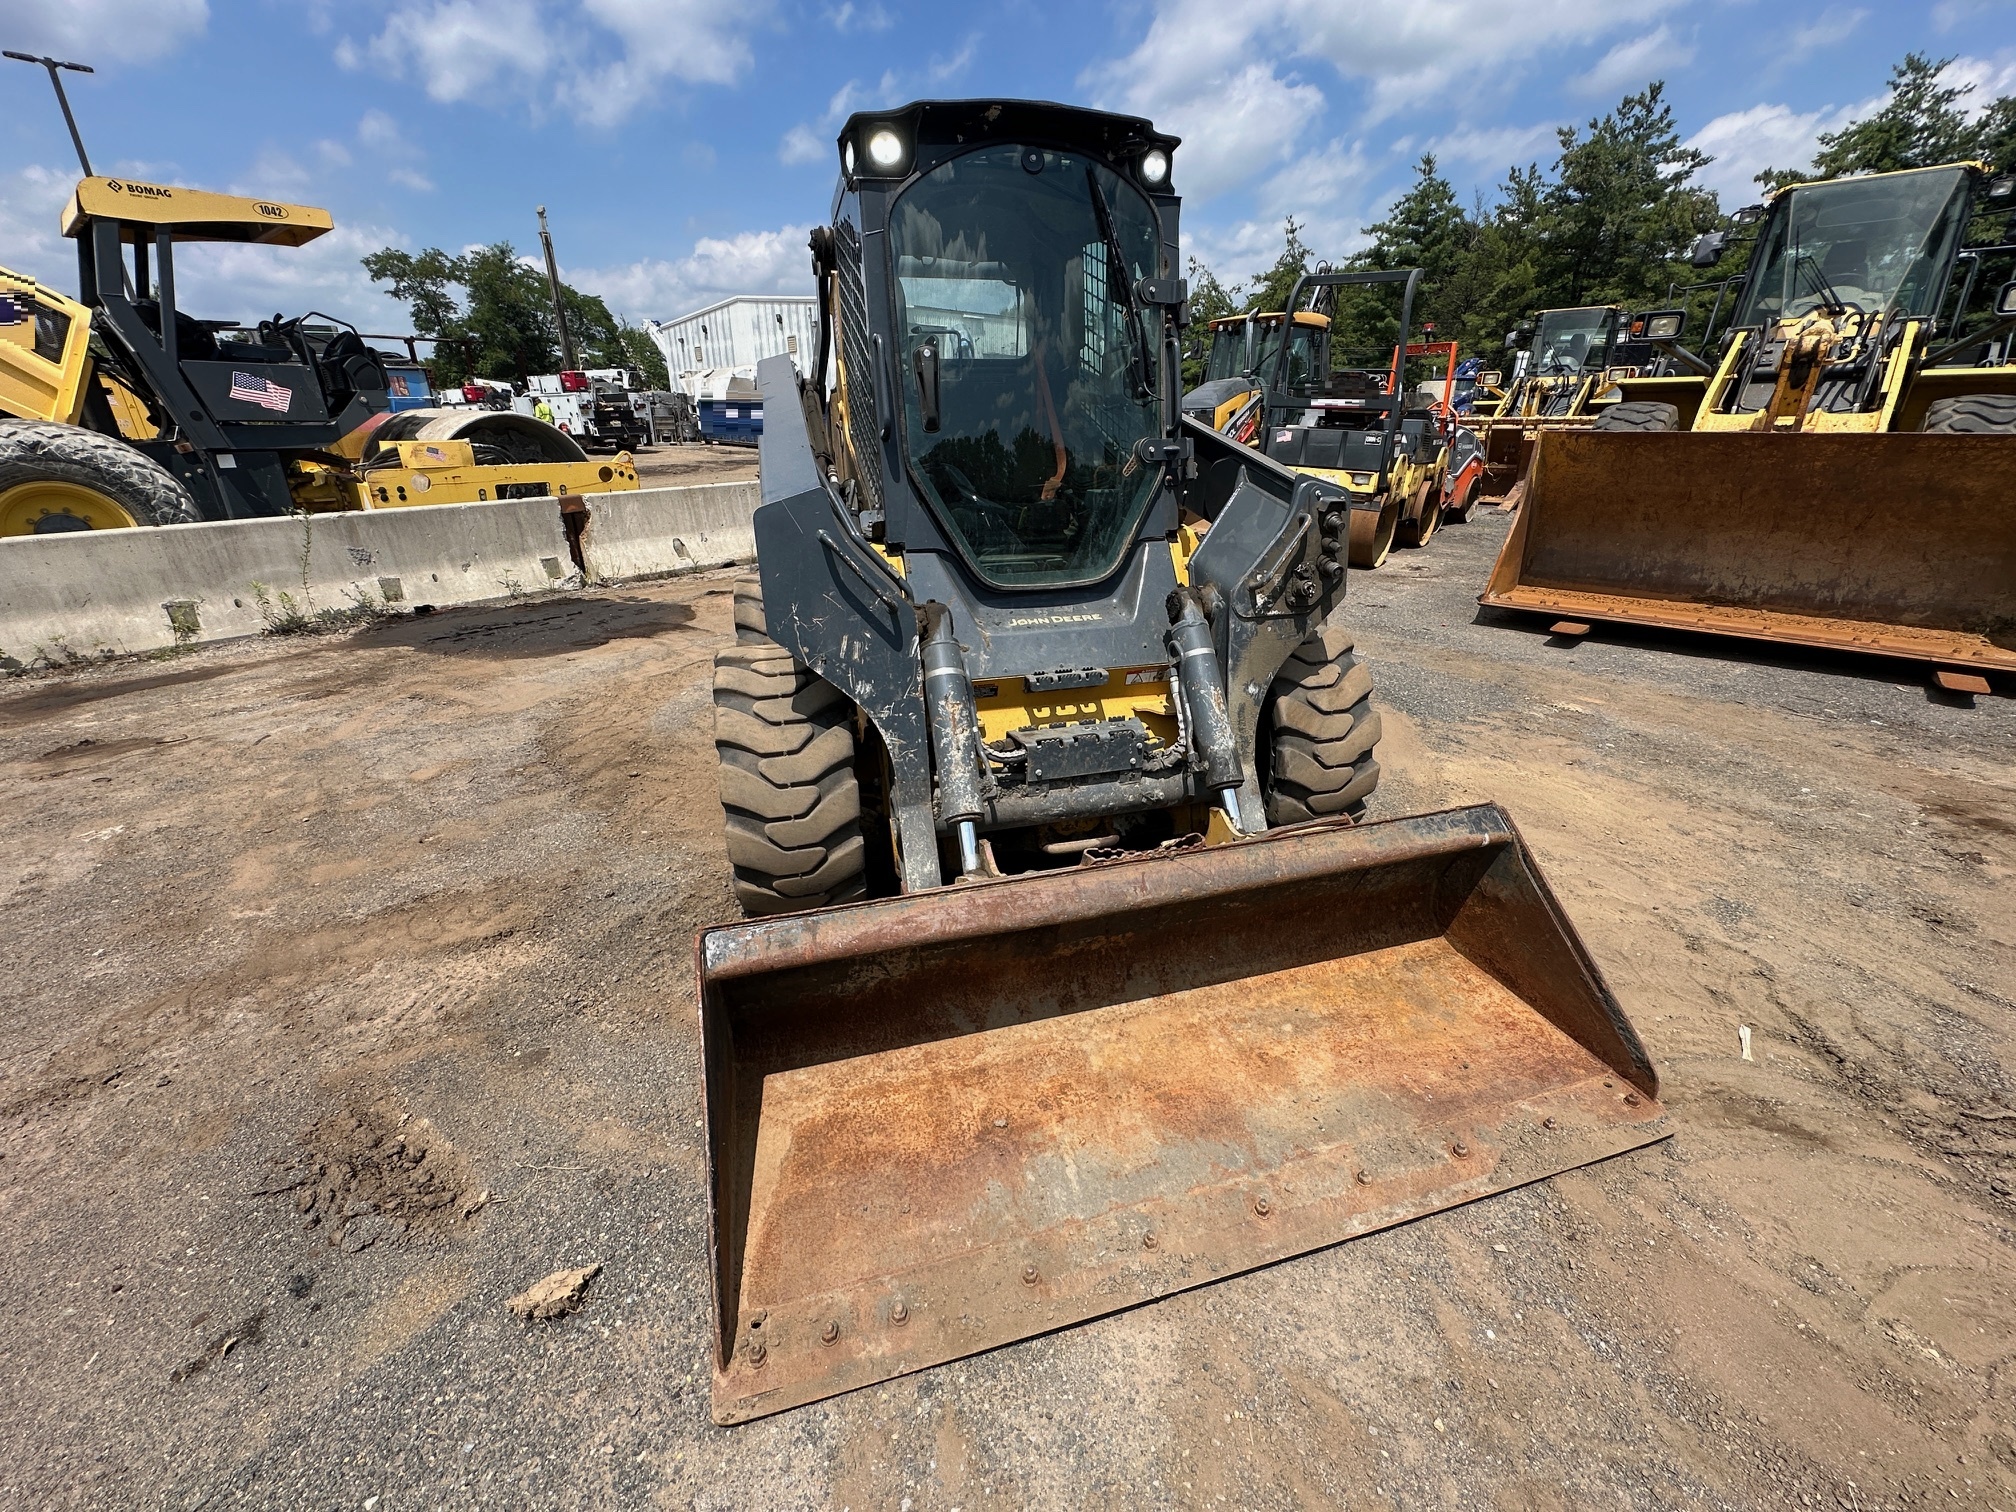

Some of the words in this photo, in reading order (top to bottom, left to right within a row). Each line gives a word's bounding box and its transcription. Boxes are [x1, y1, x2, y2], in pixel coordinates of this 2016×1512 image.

[126, 183, 172, 198] BOMAG
[259, 204, 284, 218] 1042
[1008, 618, 1050, 626] JOHN
[1051, 613, 1102, 623] DEERE
